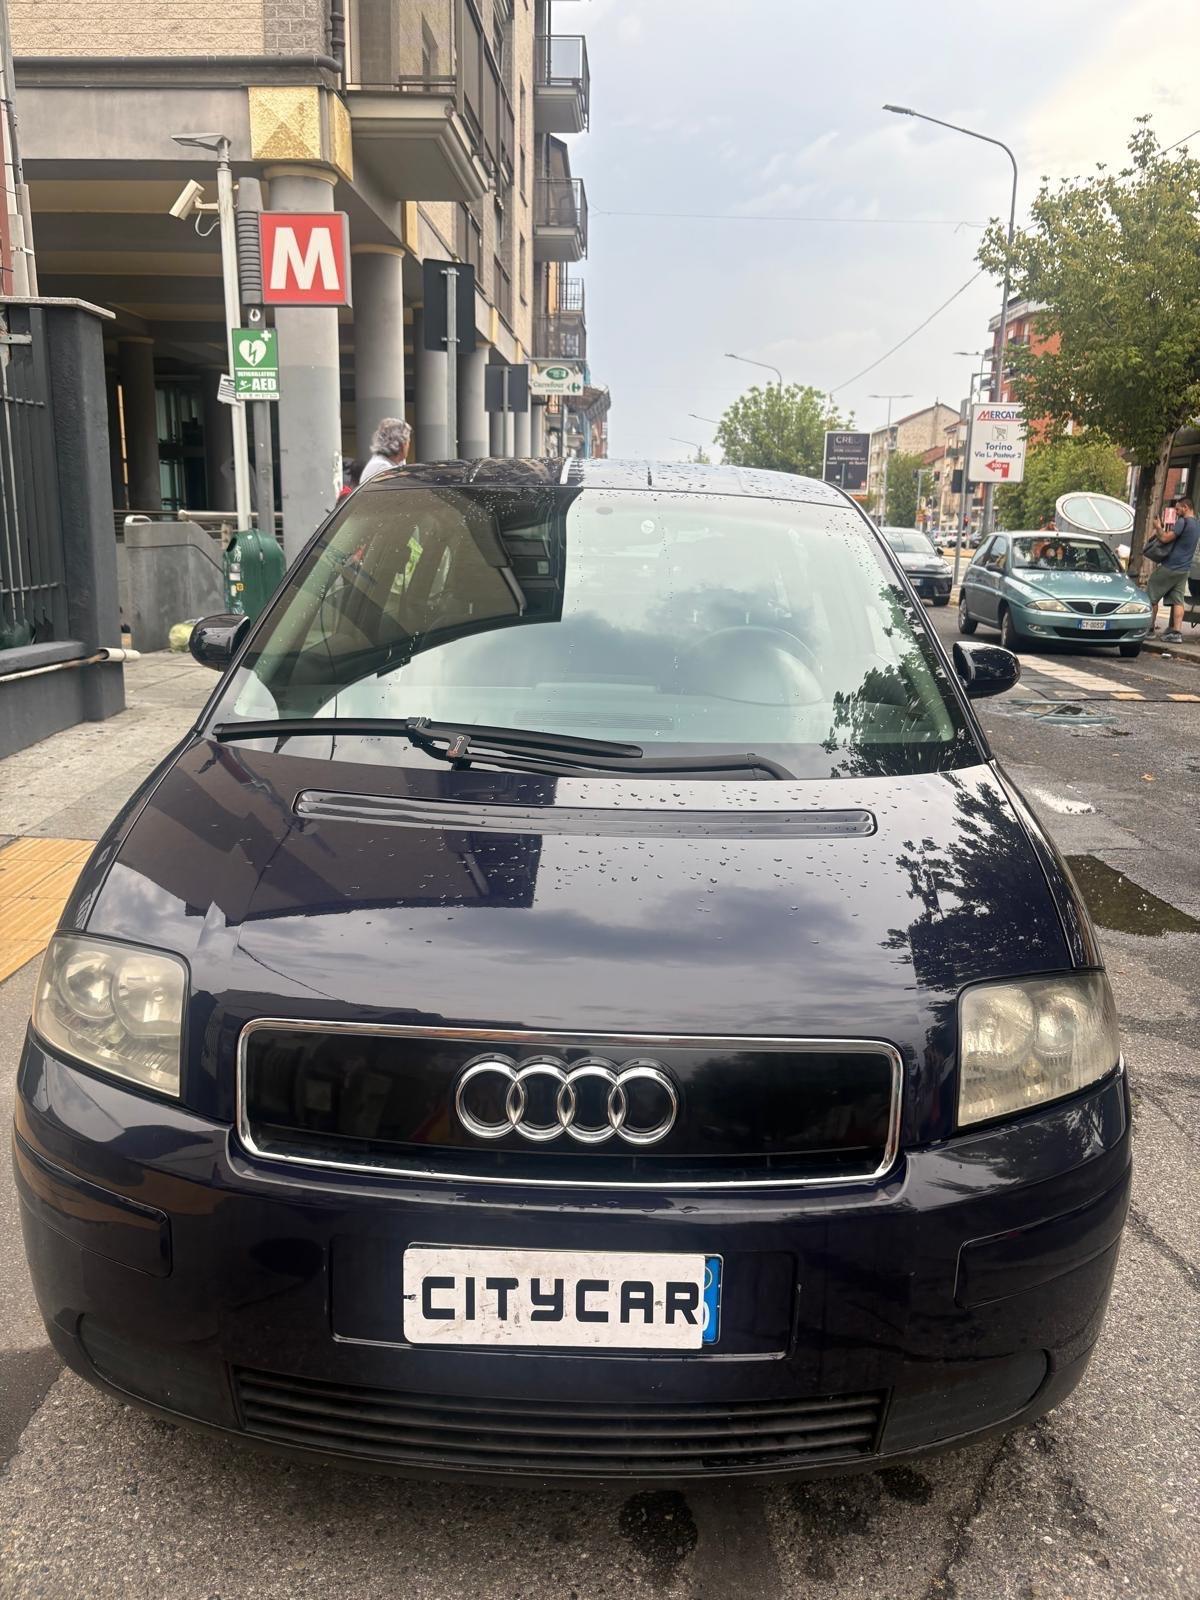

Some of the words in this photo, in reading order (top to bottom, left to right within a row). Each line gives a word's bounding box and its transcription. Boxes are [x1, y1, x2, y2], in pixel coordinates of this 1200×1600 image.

[269, 227, 340, 291] M
[252, 378, 277, 391] AED
[985, 442, 1013, 451] Torino
[421, 1276, 700, 1325] CITYCAR
